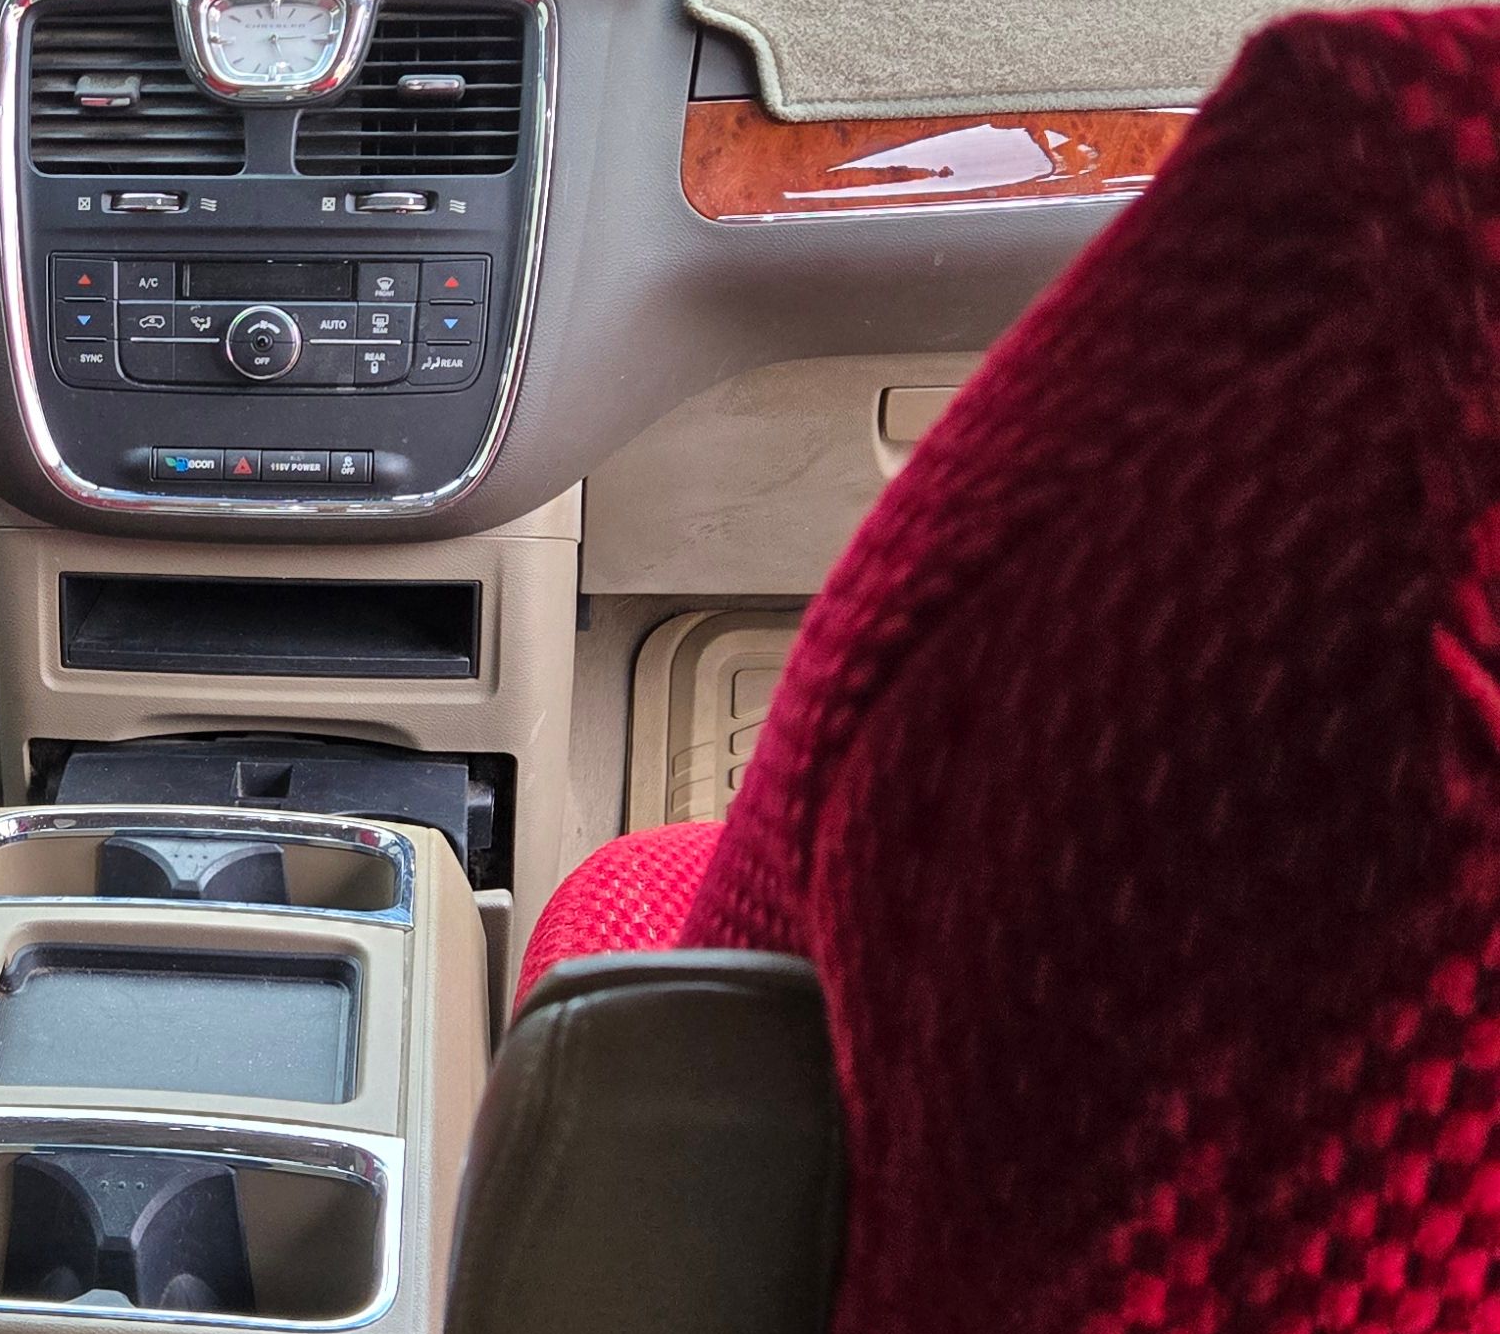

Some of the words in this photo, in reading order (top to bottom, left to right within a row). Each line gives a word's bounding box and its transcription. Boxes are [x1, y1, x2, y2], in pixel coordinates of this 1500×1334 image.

[139, 278, 159, 289] A/C
[320, 320, 348, 330] AUTO
[80, 354, 104, 363] SYNC
[254, 357, 270, 365] OFF
[364, 352, 386, 361] REAR
[440, 358, 463, 368] REAR
[188, 459, 215, 469] econ
[291, 463, 321, 472] POWER
[341, 467, 355, 475] OFF
